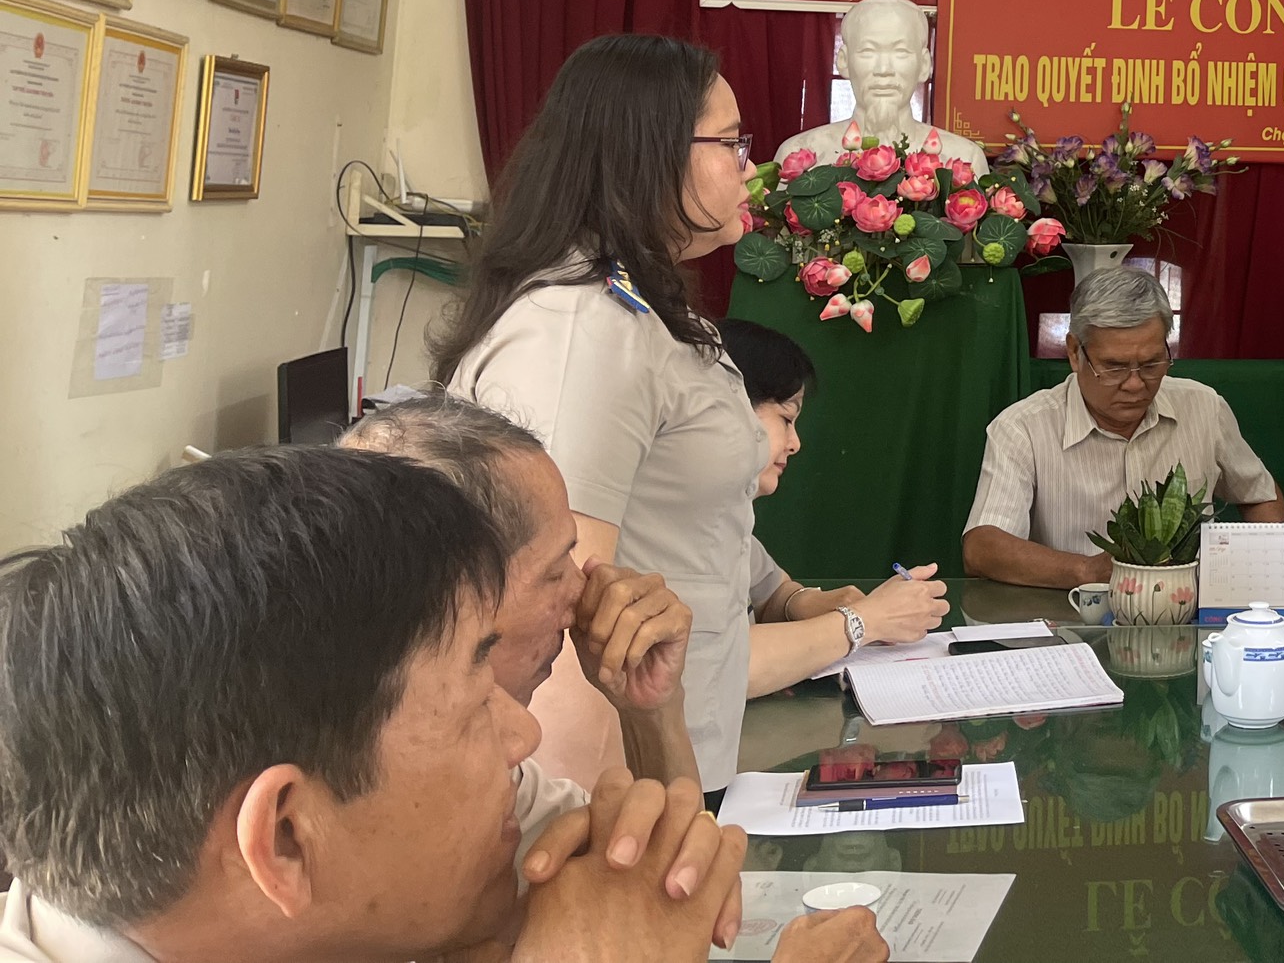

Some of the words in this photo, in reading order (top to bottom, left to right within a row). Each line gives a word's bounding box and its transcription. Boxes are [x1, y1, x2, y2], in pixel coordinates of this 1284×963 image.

[973, 54, 1029, 102] TRAO
[1037, 43, 1106, 107] QUYẾT
[1172, 42, 1202, 105] BỔ
[1207, 53, 1276, 116] NHIỆM
